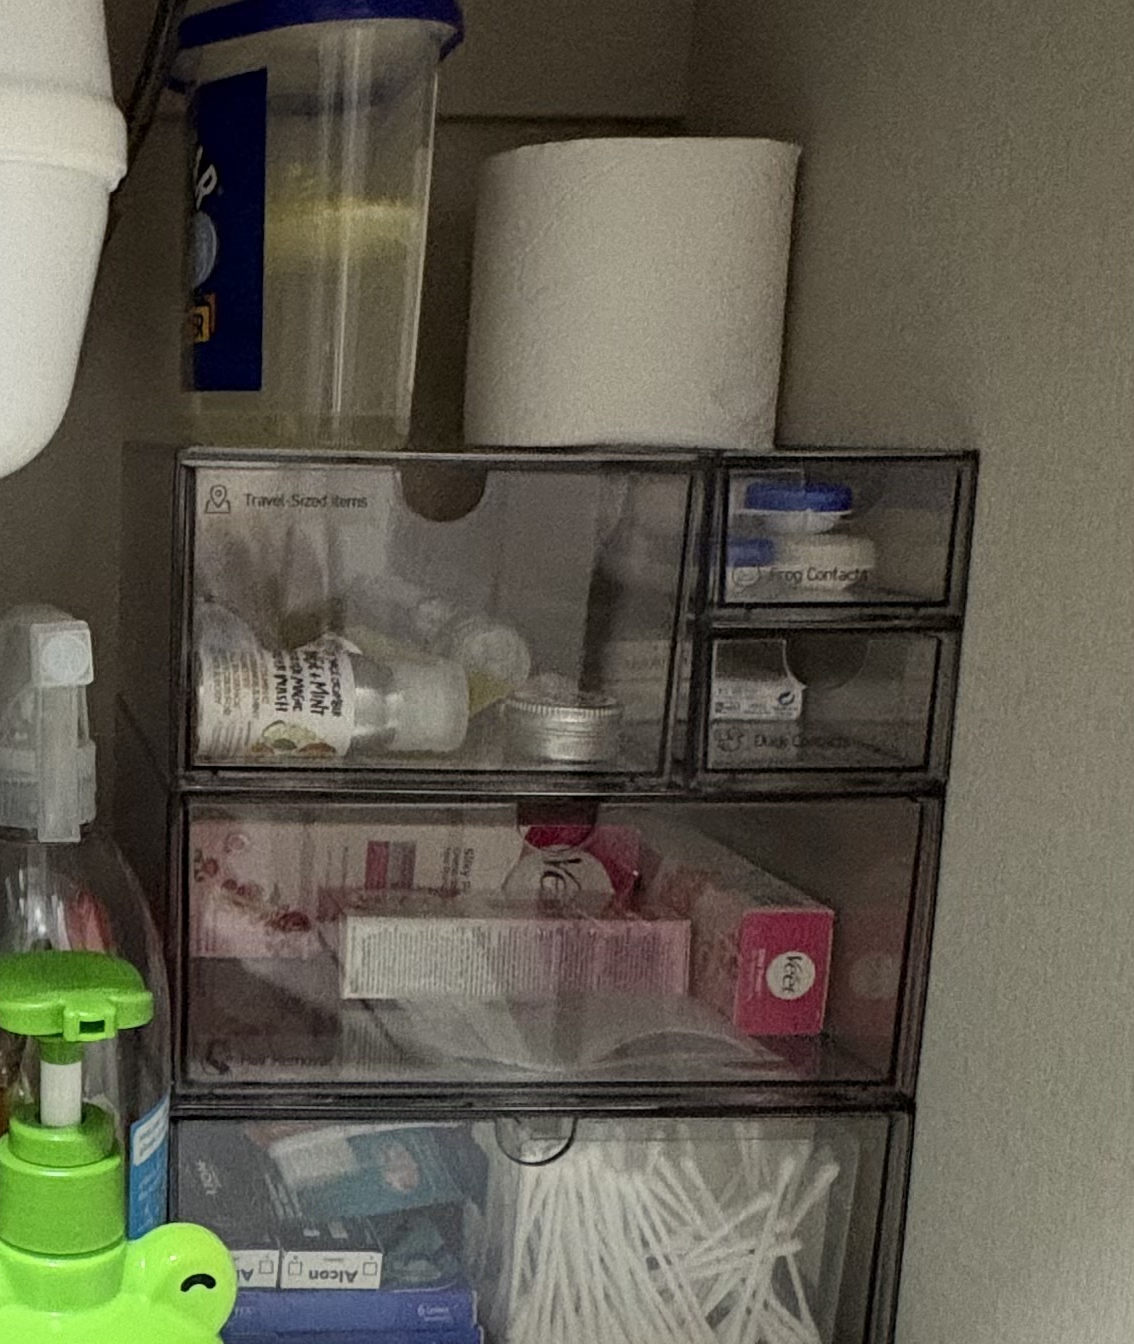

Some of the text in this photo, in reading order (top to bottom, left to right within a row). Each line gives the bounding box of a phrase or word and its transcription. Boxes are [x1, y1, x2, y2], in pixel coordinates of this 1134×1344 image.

[770, 567, 869, 584] Frog Contacts
[308, 1268, 358, 1283] Alcon
